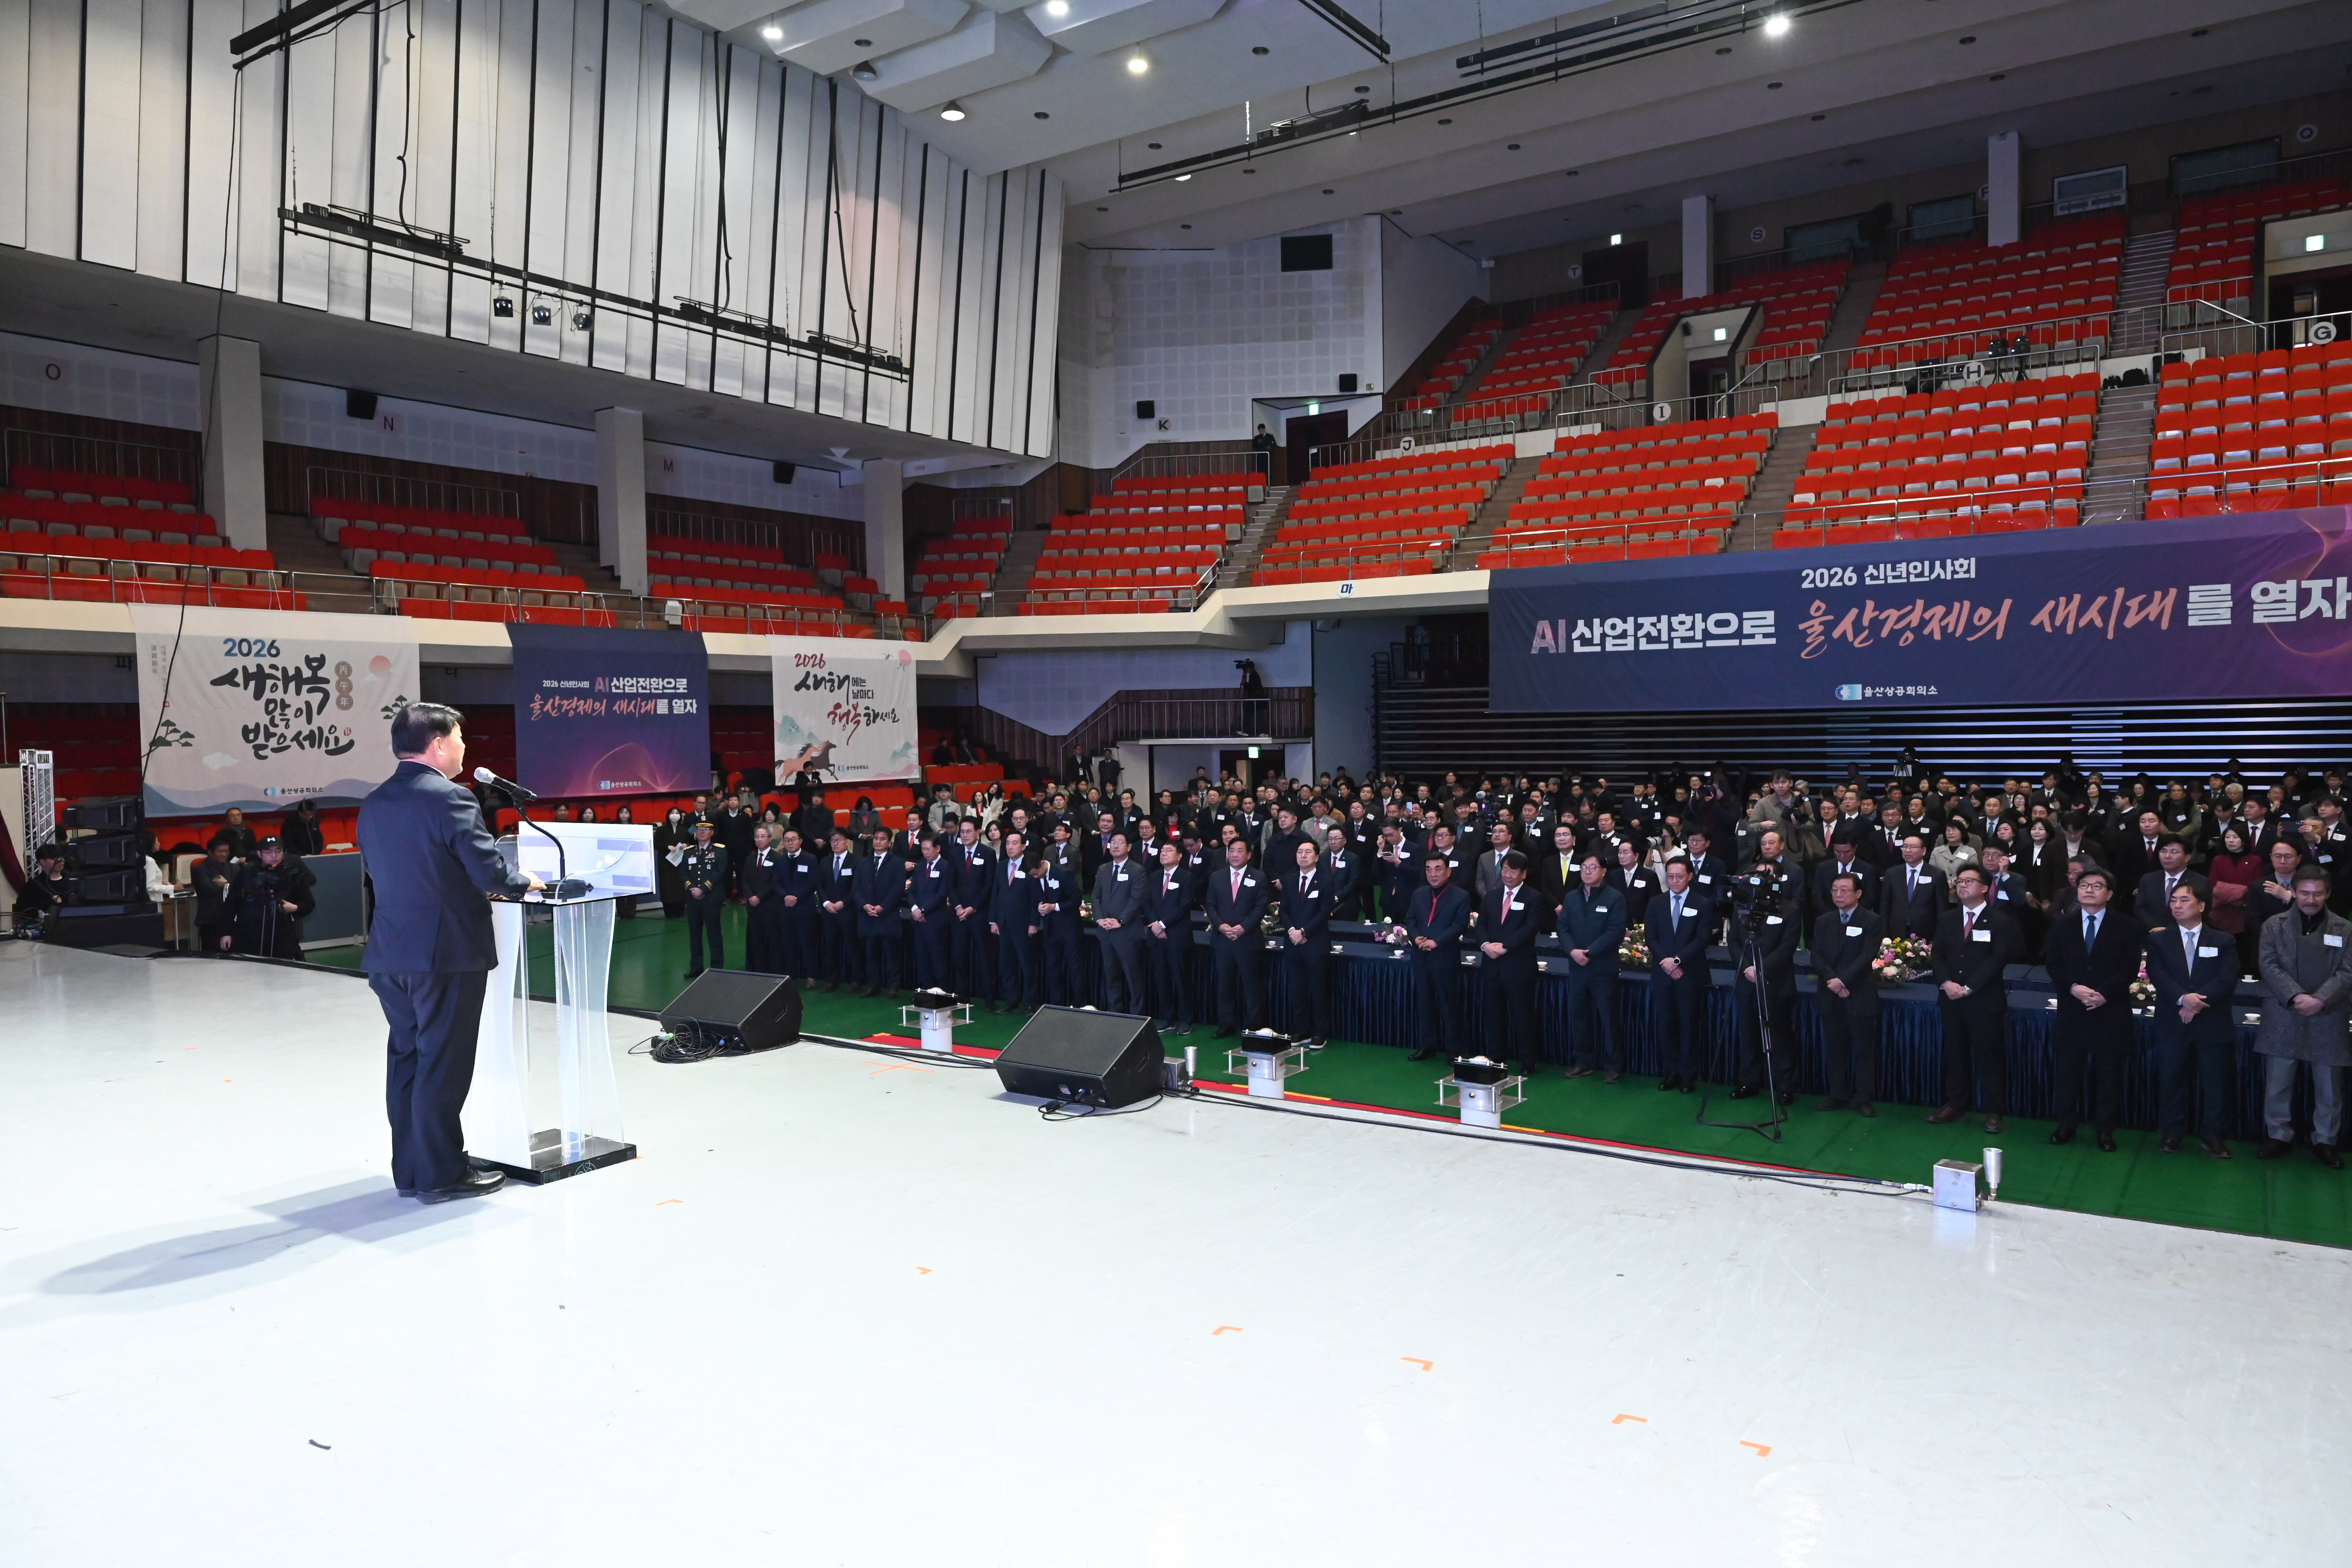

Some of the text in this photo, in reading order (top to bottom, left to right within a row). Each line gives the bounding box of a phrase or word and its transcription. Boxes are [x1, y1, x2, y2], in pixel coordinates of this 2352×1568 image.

[347, 226, 353, 234] 9
[396, 238, 401, 247] 8
[1753, 229, 1763, 240] S
[522, 271, 527, 279] 6
[1570, 267, 1579, 277] T
[2314, 325, 2332, 340] G
[46, 363, 61, 380] O
[1967, 364, 1981, 379] H
[1659, 406, 1665, 419] I
[384, 416, 394, 431] N
[1159, 420, 1169, 430] K
[1402, 440, 1412, 451] J
[664, 459, 673, 472] M
[1802, 557, 1976, 589] 2026 신년인사회
[1341, 584, 1353, 594] 마
[1798, 598, 2013, 659] 울산경제의
[2251, 577, 2352, 623] 열자
[1530, 610, 1777, 654] AI 산업전환으로
[223, 638, 280, 658] 2026
[794, 653, 826, 669] 2026
[560, 680, 590, 688] 신년인사회
[594, 677, 688, 693] AI 산업전환으로
[1864, 684, 1938, 697] 울산상공회의소
[852, 689, 874, 700] 날마다
[264, 697, 313, 730] 많이
[530, 693, 607, 721] 울산경제의
[672, 699, 697, 714] 열자
[827, 702, 900, 746] 행복하세요
[241, 722, 355, 761] 받으세요
[280, 787, 323, 795] 울산상공회의소
